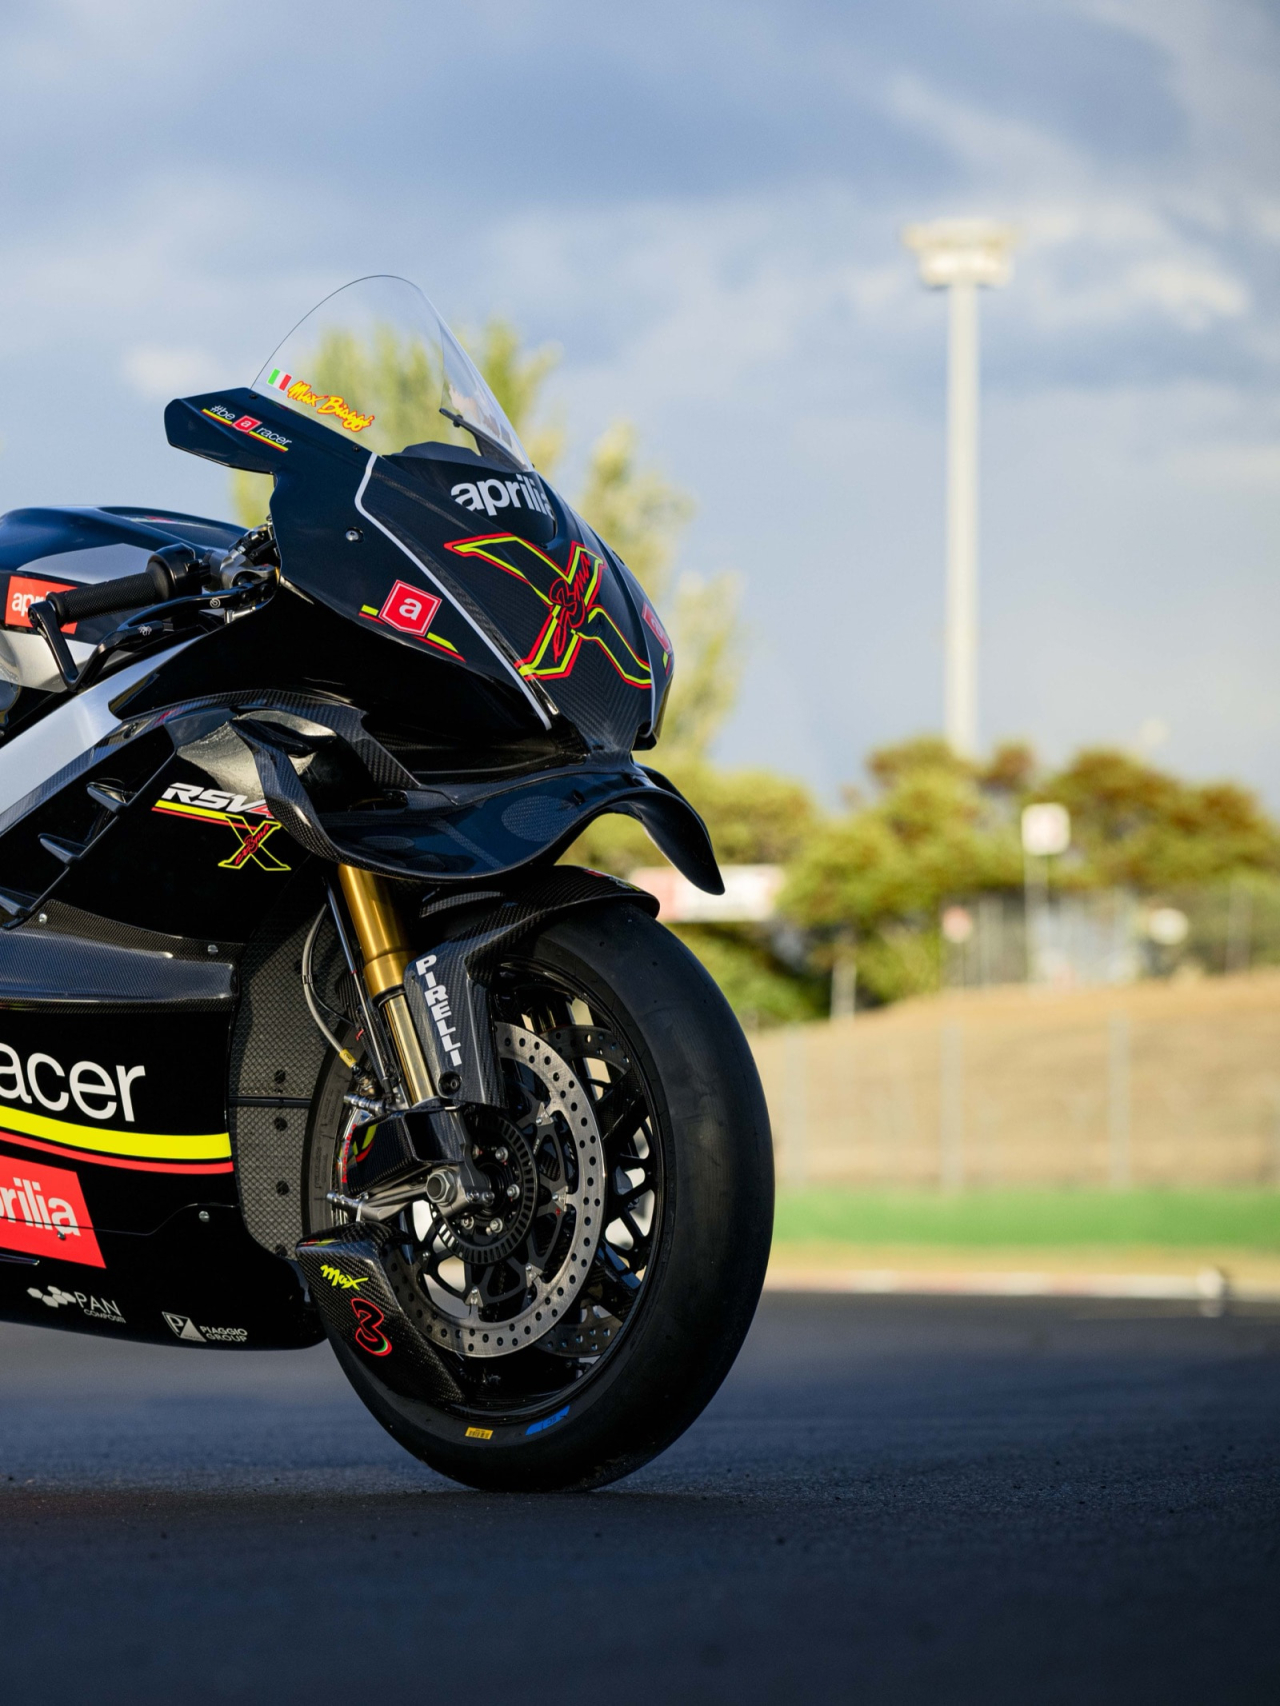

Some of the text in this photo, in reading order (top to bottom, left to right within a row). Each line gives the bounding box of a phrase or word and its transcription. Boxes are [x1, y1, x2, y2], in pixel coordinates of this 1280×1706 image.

[210, 405, 236, 421] #be
[256, 427, 292, 445] racer
[399, 598, 422, 621] a
[416, 954, 462, 1067] PIRELLI
[74, 1291, 122, 1316] PAN
[199, 1325, 248, 1336] PIAGGIO
[206, 1333, 247, 1342] GROUP
[350, 1298, 393, 1356] 3
